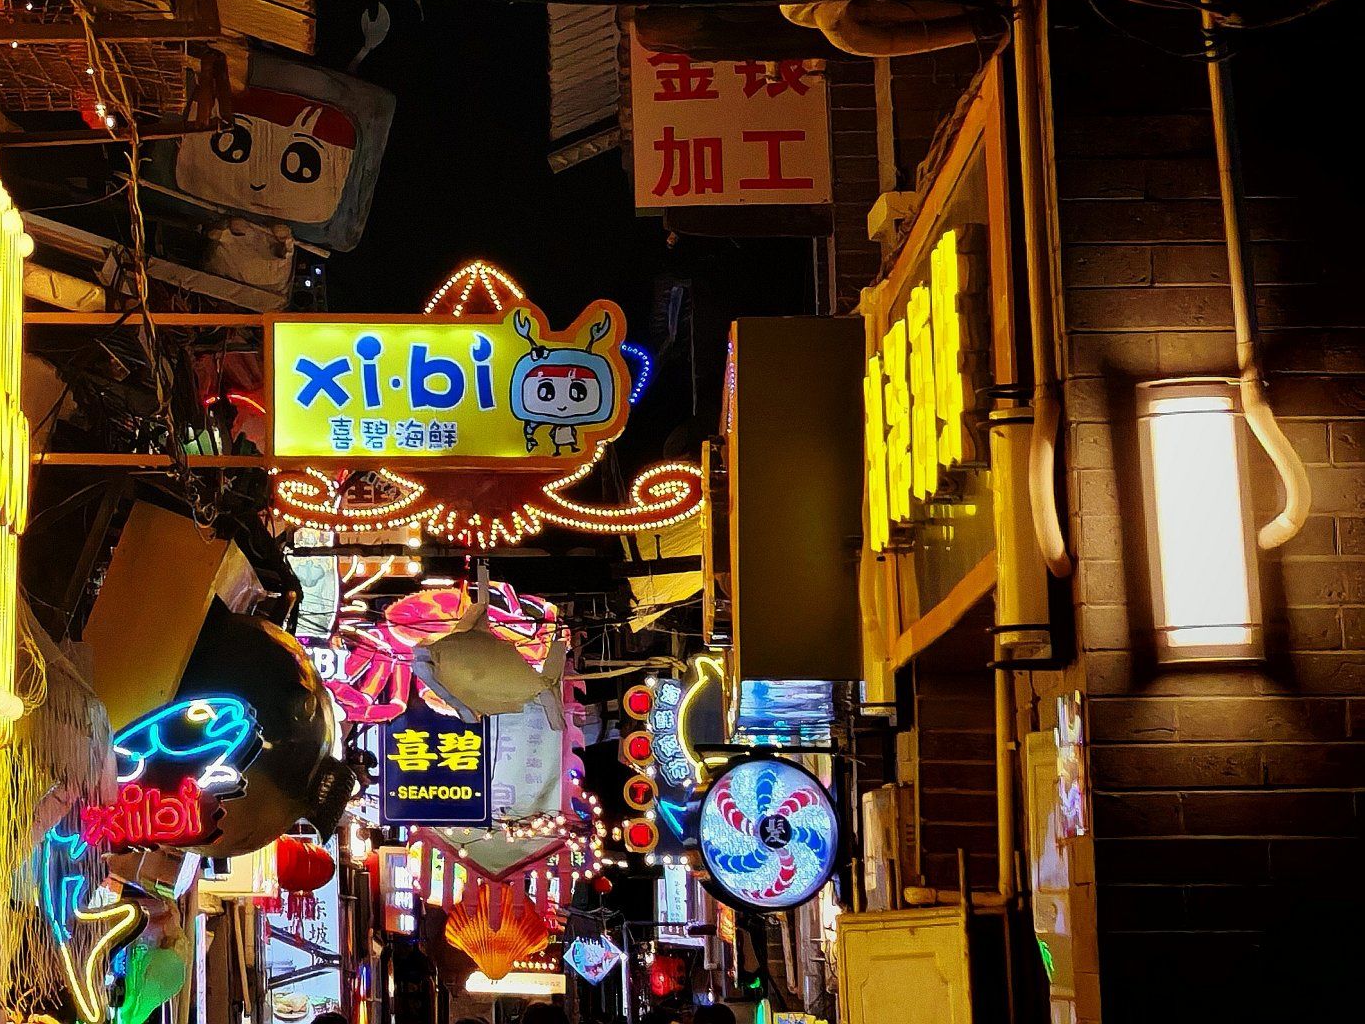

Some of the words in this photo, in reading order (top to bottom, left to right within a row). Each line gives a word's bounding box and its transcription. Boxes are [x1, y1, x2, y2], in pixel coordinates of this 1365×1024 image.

[651, 126, 814, 197] 加工
[330, 417, 457, 450] 喜碧海鲜
[305, 647, 349, 682] BI
[386, 728, 482, 772] 喜碧
[397, 785, 472, 800] SEAFOOD
